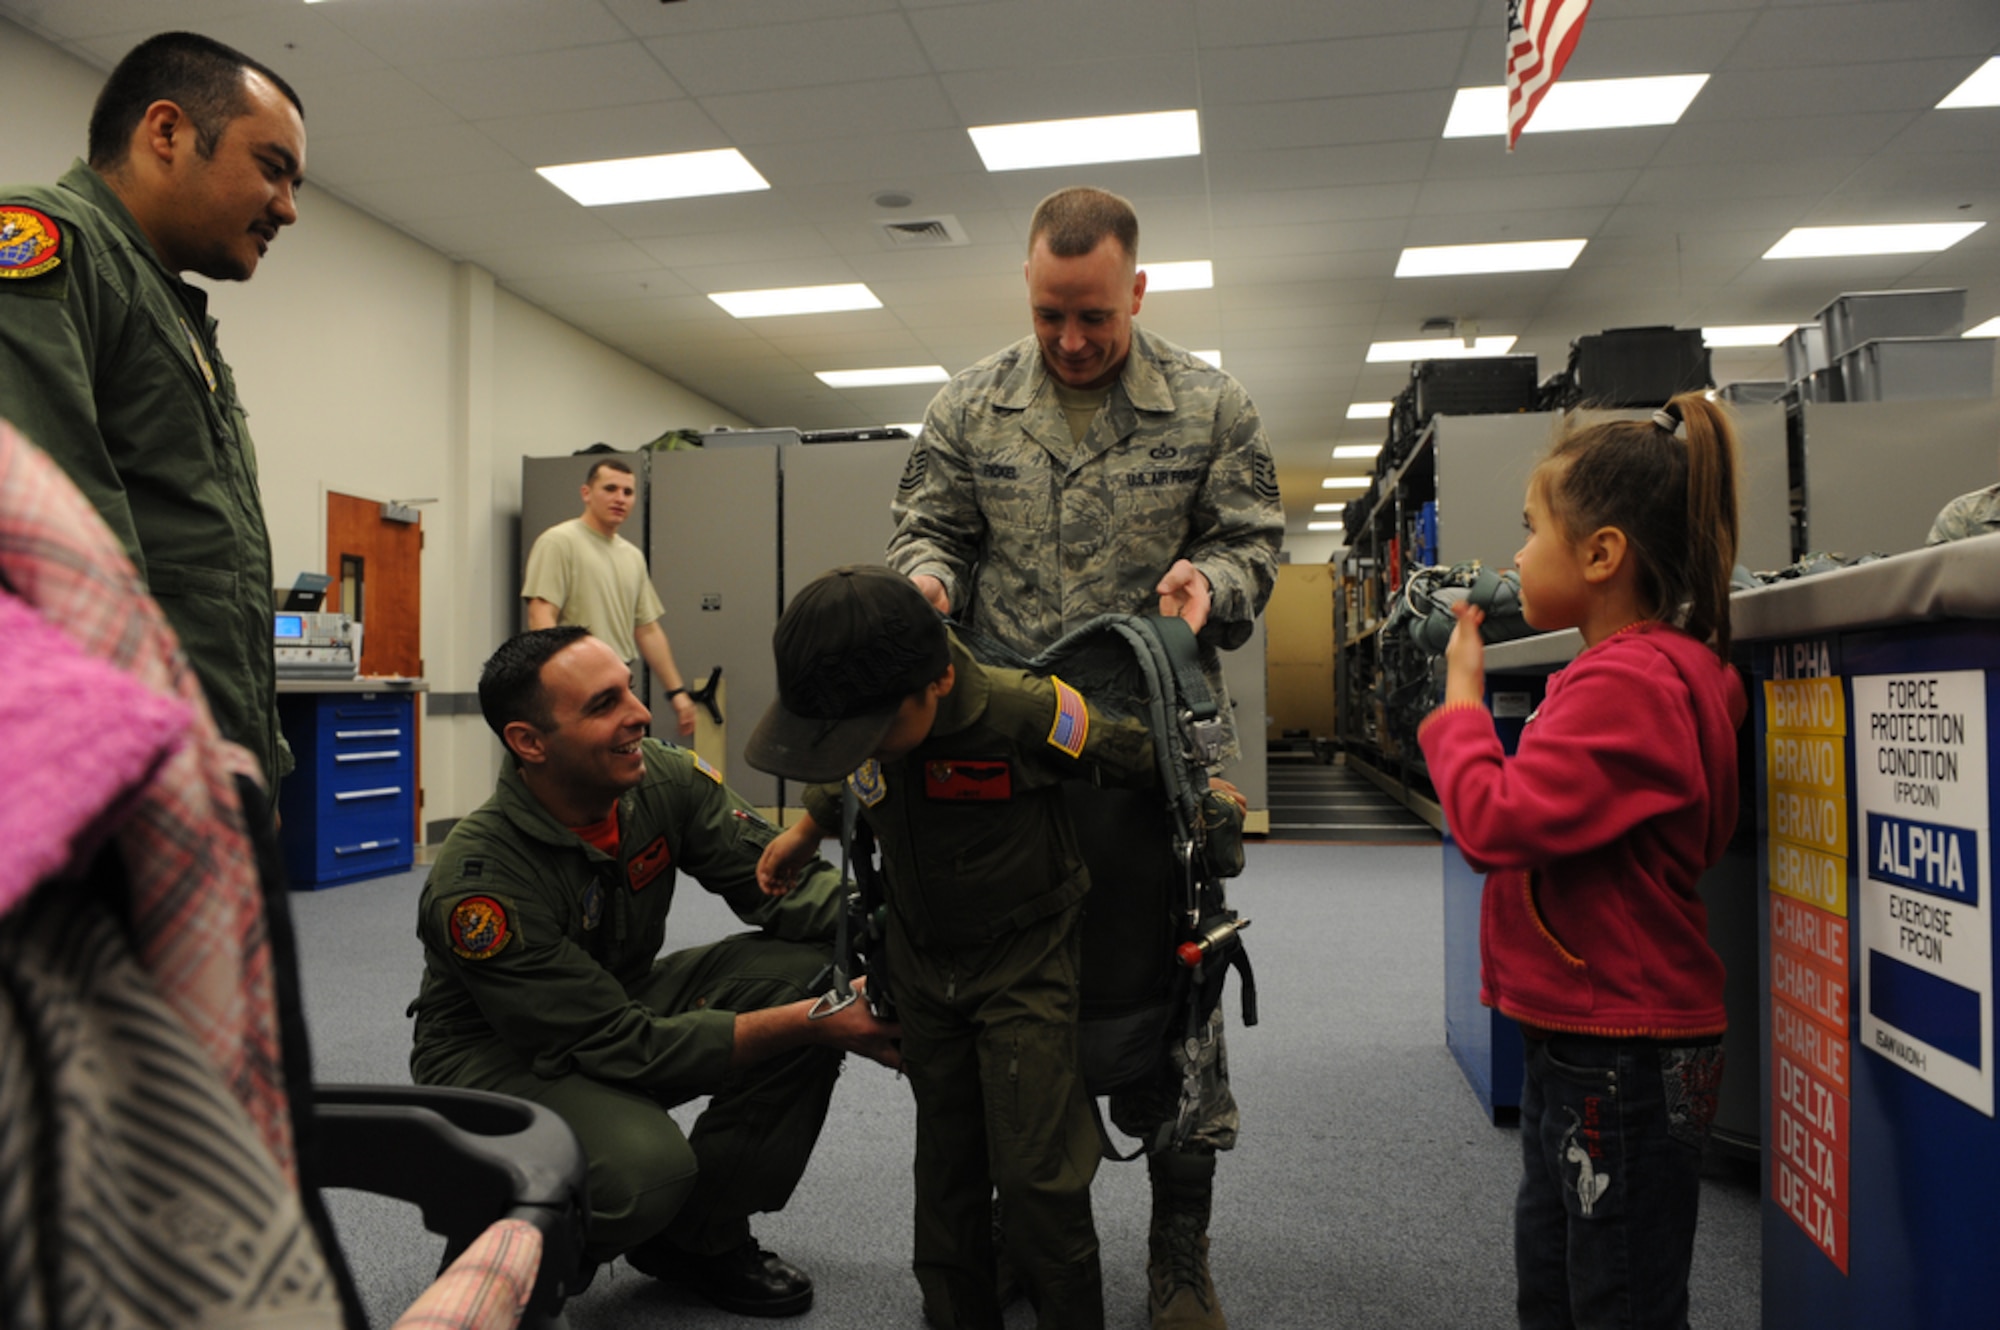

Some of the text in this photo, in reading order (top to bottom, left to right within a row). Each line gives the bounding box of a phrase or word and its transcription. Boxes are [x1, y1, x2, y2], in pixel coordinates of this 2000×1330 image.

[1773, 641, 1831, 680] ALPHA
[1773, 682, 1835, 728] BRAVO
[1888, 680, 1938, 709] FORCE
[1871, 713, 1964, 745] PROTECTION
[1774, 738, 1835, 787] BRAVO
[1878, 747, 1958, 782] CONDITION
[1775, 792, 1837, 846] BRAVO
[1893, 781, 1940, 810] (FPCON)
[1776, 846, 1837, 905] BRAVO
[1878, 821, 1965, 892] ALPHA
[1773, 901, 1844, 966] CHARLIE
[1890, 894, 1952, 937] EXERCISE
[1899, 926, 1943, 964] FPCON
[1774, 953, 1844, 1027] CHARLIE
[1775, 1006, 1844, 1086] CHARLIE
[1779, 1056, 1837, 1141] DELTA
[1779, 1108, 1837, 1199] DELTA
[1779, 1160, 1836, 1256] DELTA
